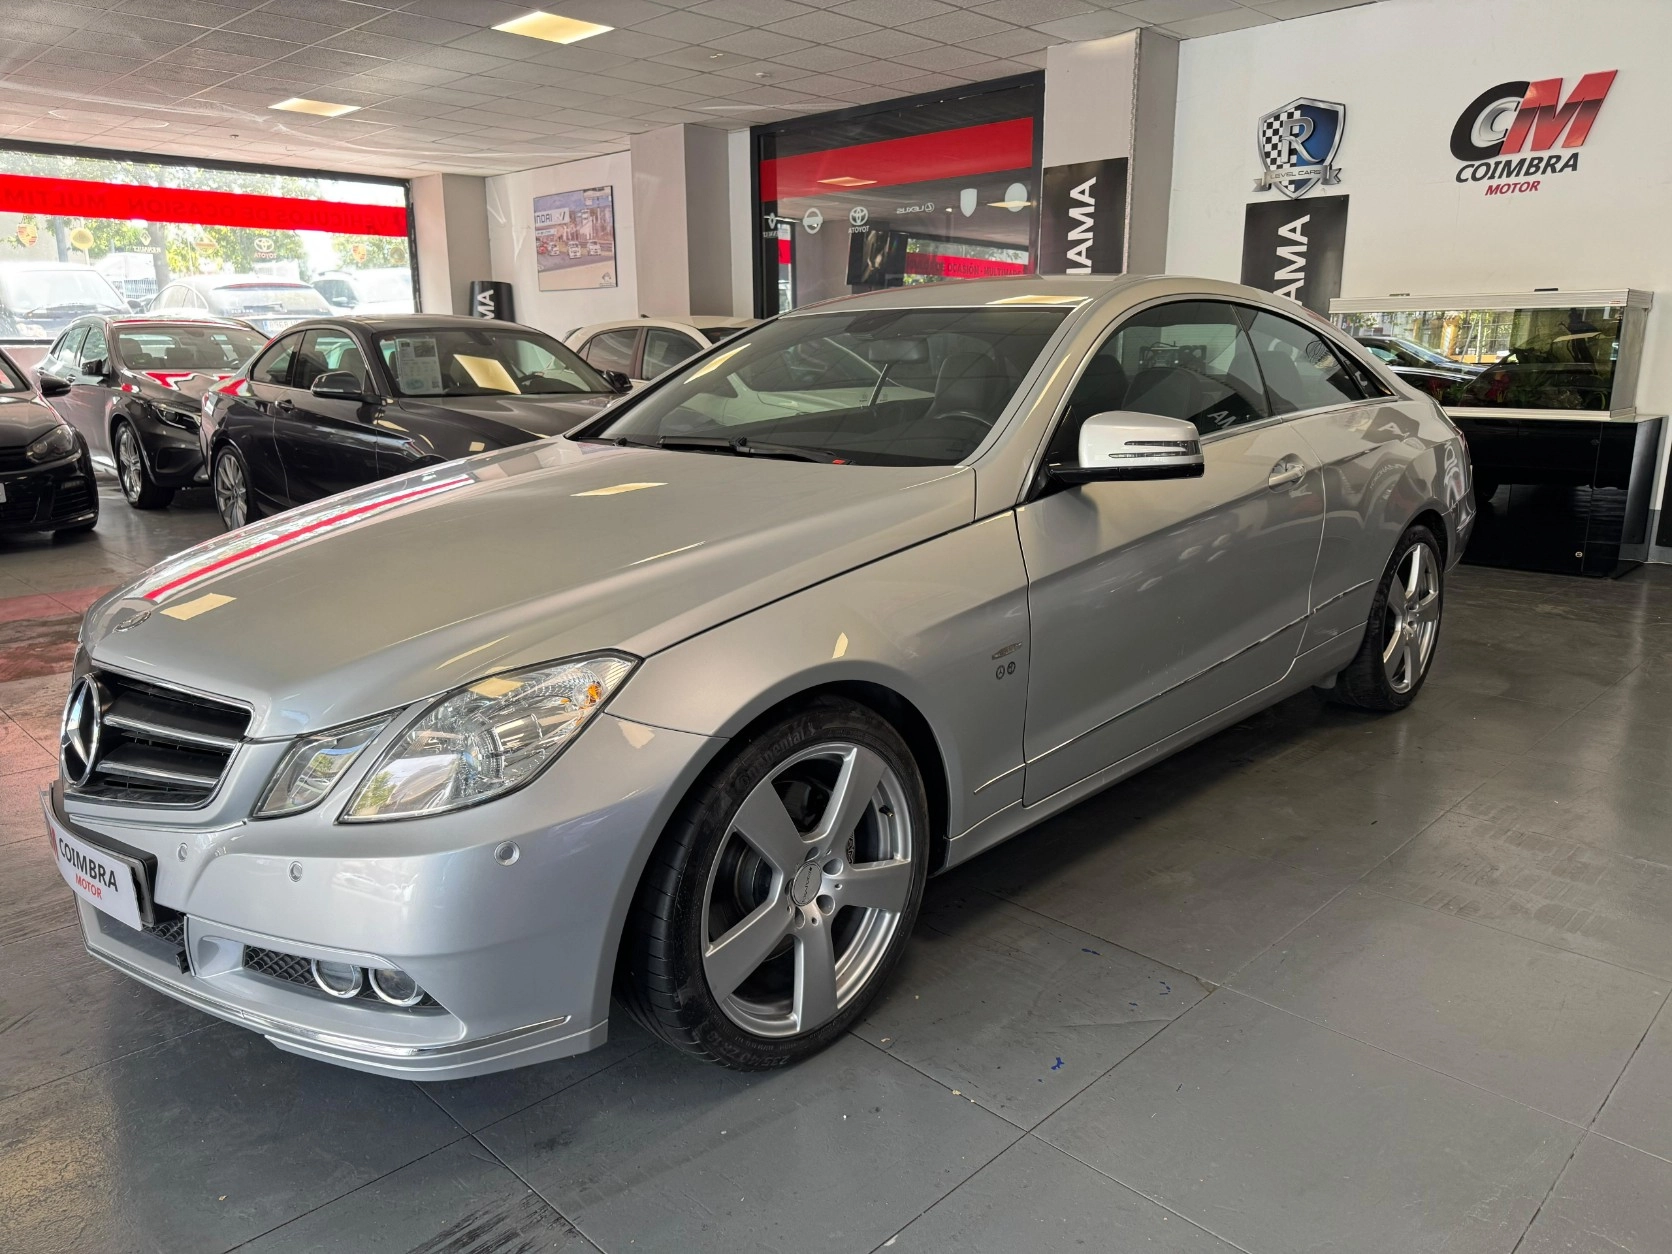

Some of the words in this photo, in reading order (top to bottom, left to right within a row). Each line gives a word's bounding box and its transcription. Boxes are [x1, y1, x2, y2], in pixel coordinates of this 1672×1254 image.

[1280, 116, 1325, 163] R
[1270, 172, 1297, 180] LEVEL
[1297, 169, 1322, 177] CARS
[1455, 152, 1580, 184] COIMBRA
[1484, 180, 1542, 196] MOTOR
[58, 837, 119, 893] COIMBRA
[75, 872, 103, 901] MOTOR
